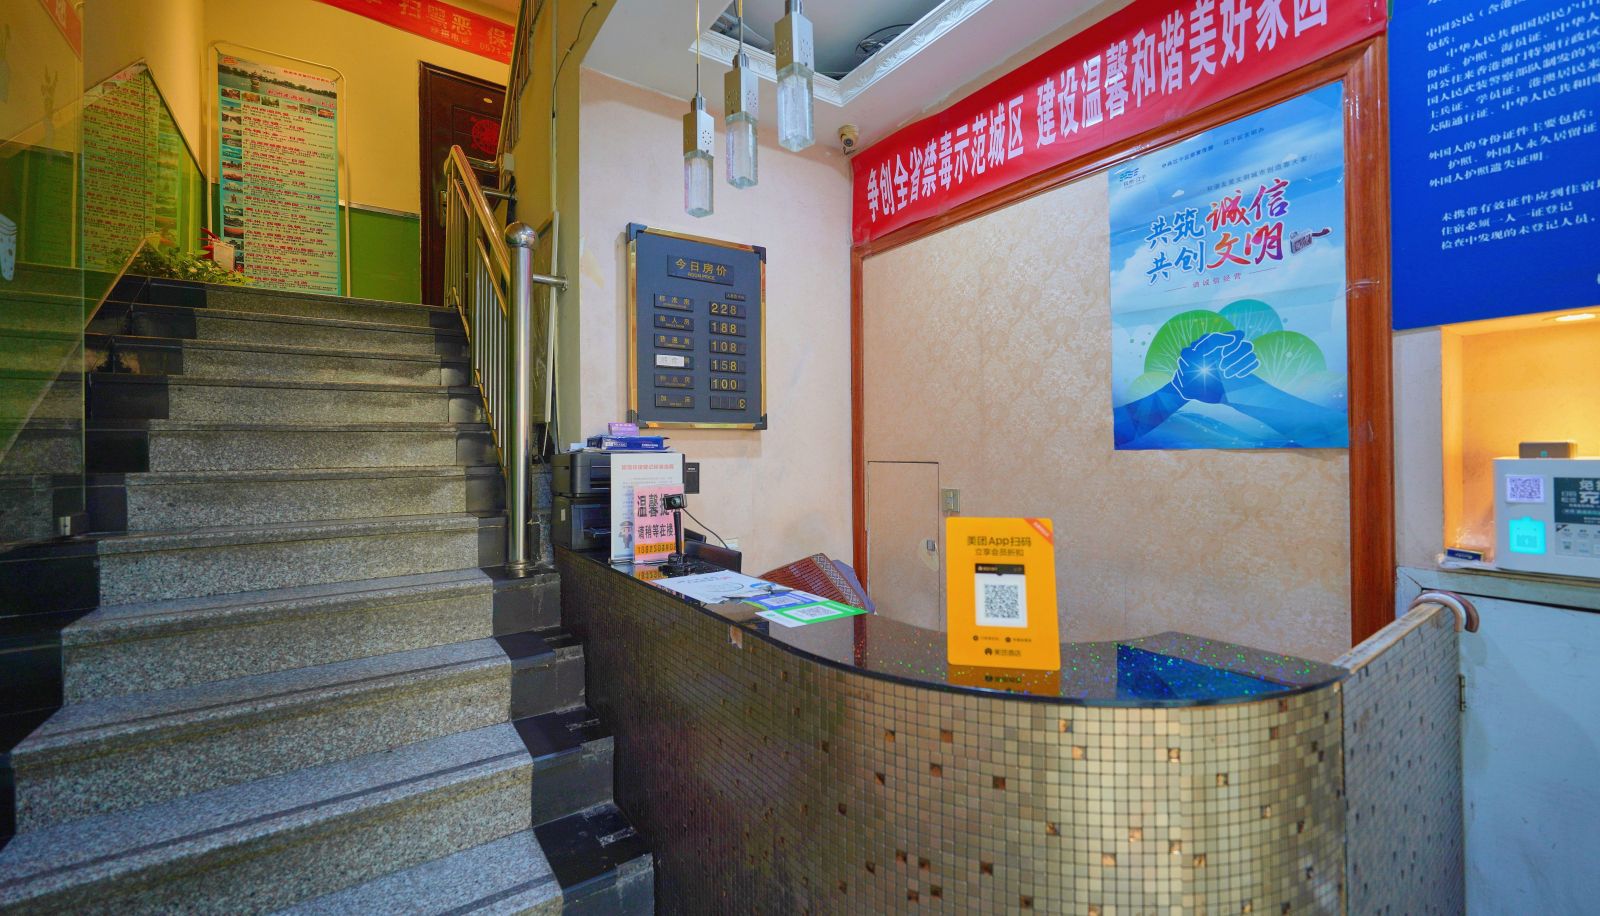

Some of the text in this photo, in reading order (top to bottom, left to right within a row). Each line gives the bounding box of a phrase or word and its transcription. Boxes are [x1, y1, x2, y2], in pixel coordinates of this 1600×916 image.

[867, 99, 1024, 223] 争创全省禁毒示范城区
[1442, 179, 1600, 222] 未携带有效证件应到住宿
[675, 258, 727, 277] 今日房价
[711, 302, 737, 315] 228
[711, 322, 737, 334] 188
[711, 341, 737, 353] 108
[712, 359, 737, 371] 158
[712, 379, 737, 390] 100
